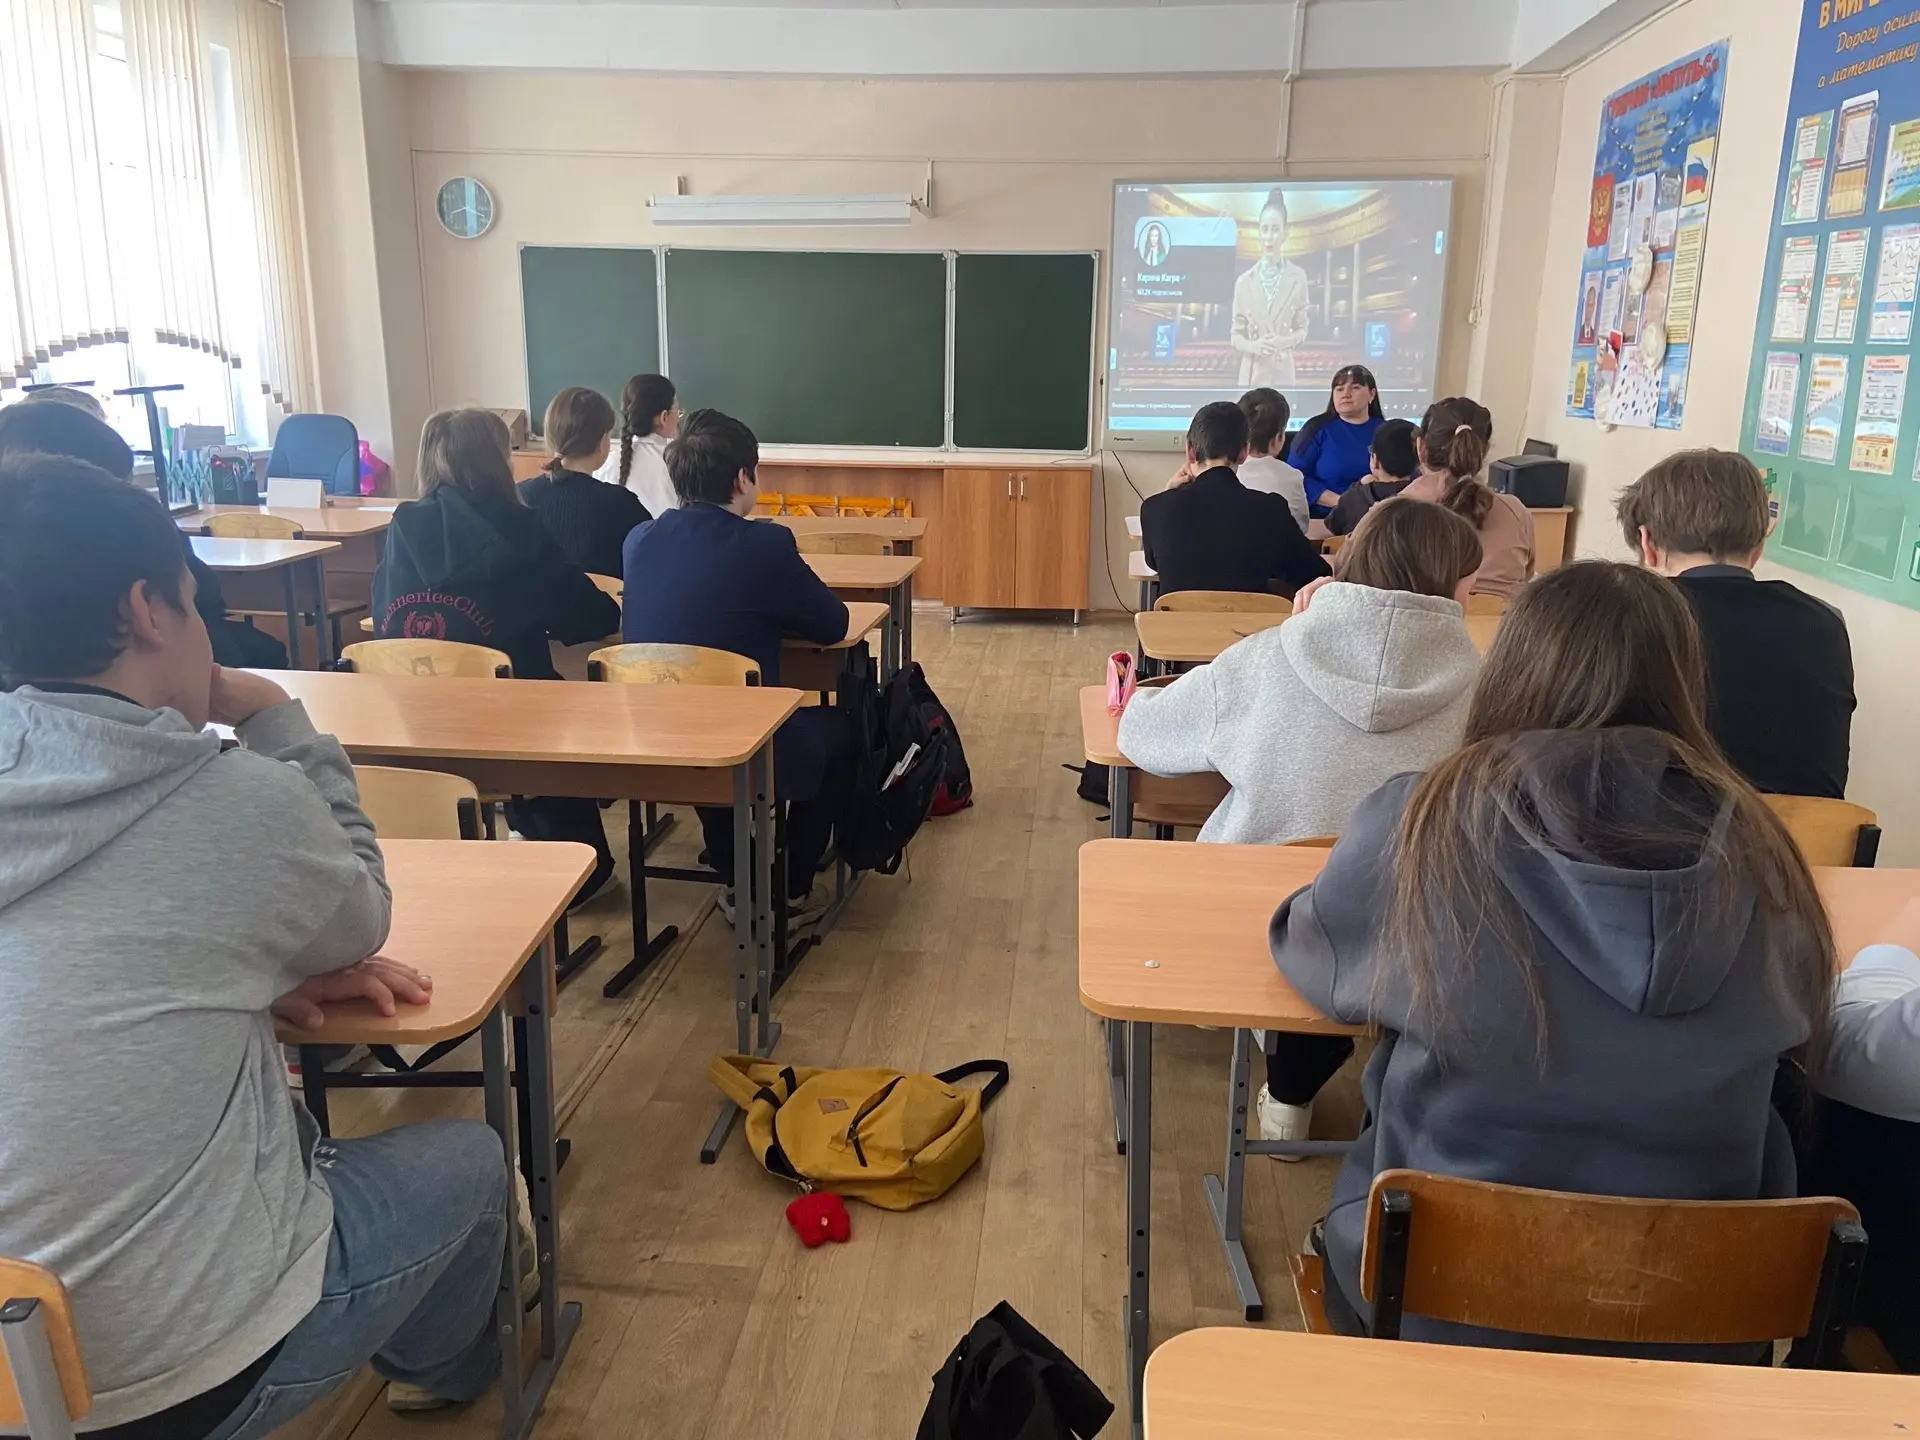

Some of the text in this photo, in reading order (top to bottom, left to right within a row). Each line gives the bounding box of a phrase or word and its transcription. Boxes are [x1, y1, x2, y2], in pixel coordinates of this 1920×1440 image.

[1818, 0, 1881, 29] В МИ
[1835, 26, 1880, 54] Дорогу
[1817, 42, 1920, 88] а математику
